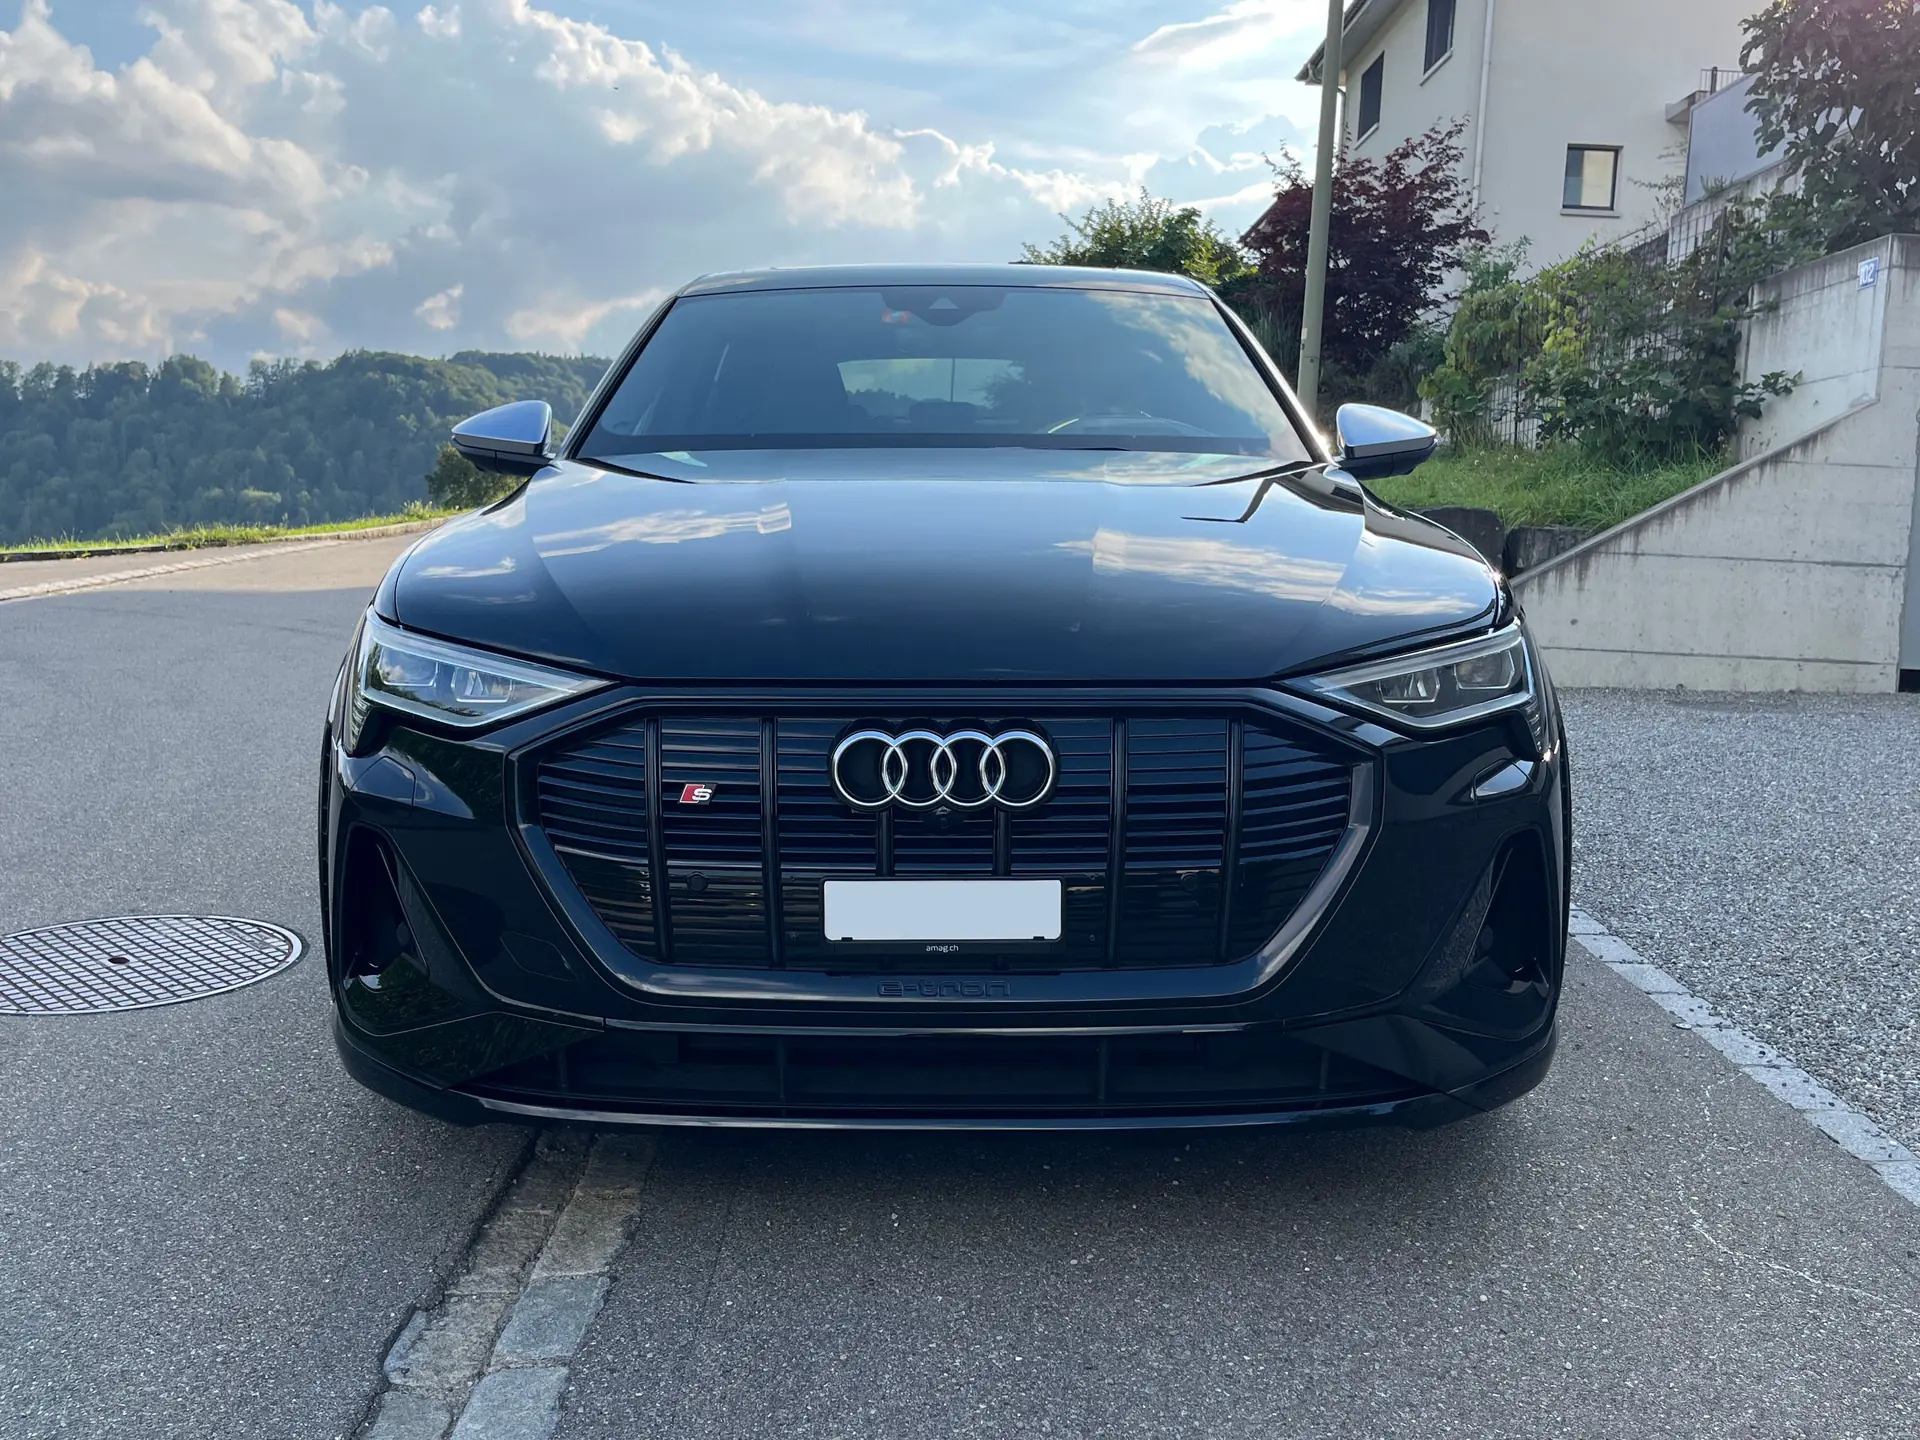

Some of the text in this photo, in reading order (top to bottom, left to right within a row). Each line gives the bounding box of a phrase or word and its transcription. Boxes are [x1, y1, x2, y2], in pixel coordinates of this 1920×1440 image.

[1860, 263, 1875, 285] 102
[692, 788, 712, 801] S
[925, 944, 959, 954] amag.ch
[878, 980, 1011, 997] e-tron
